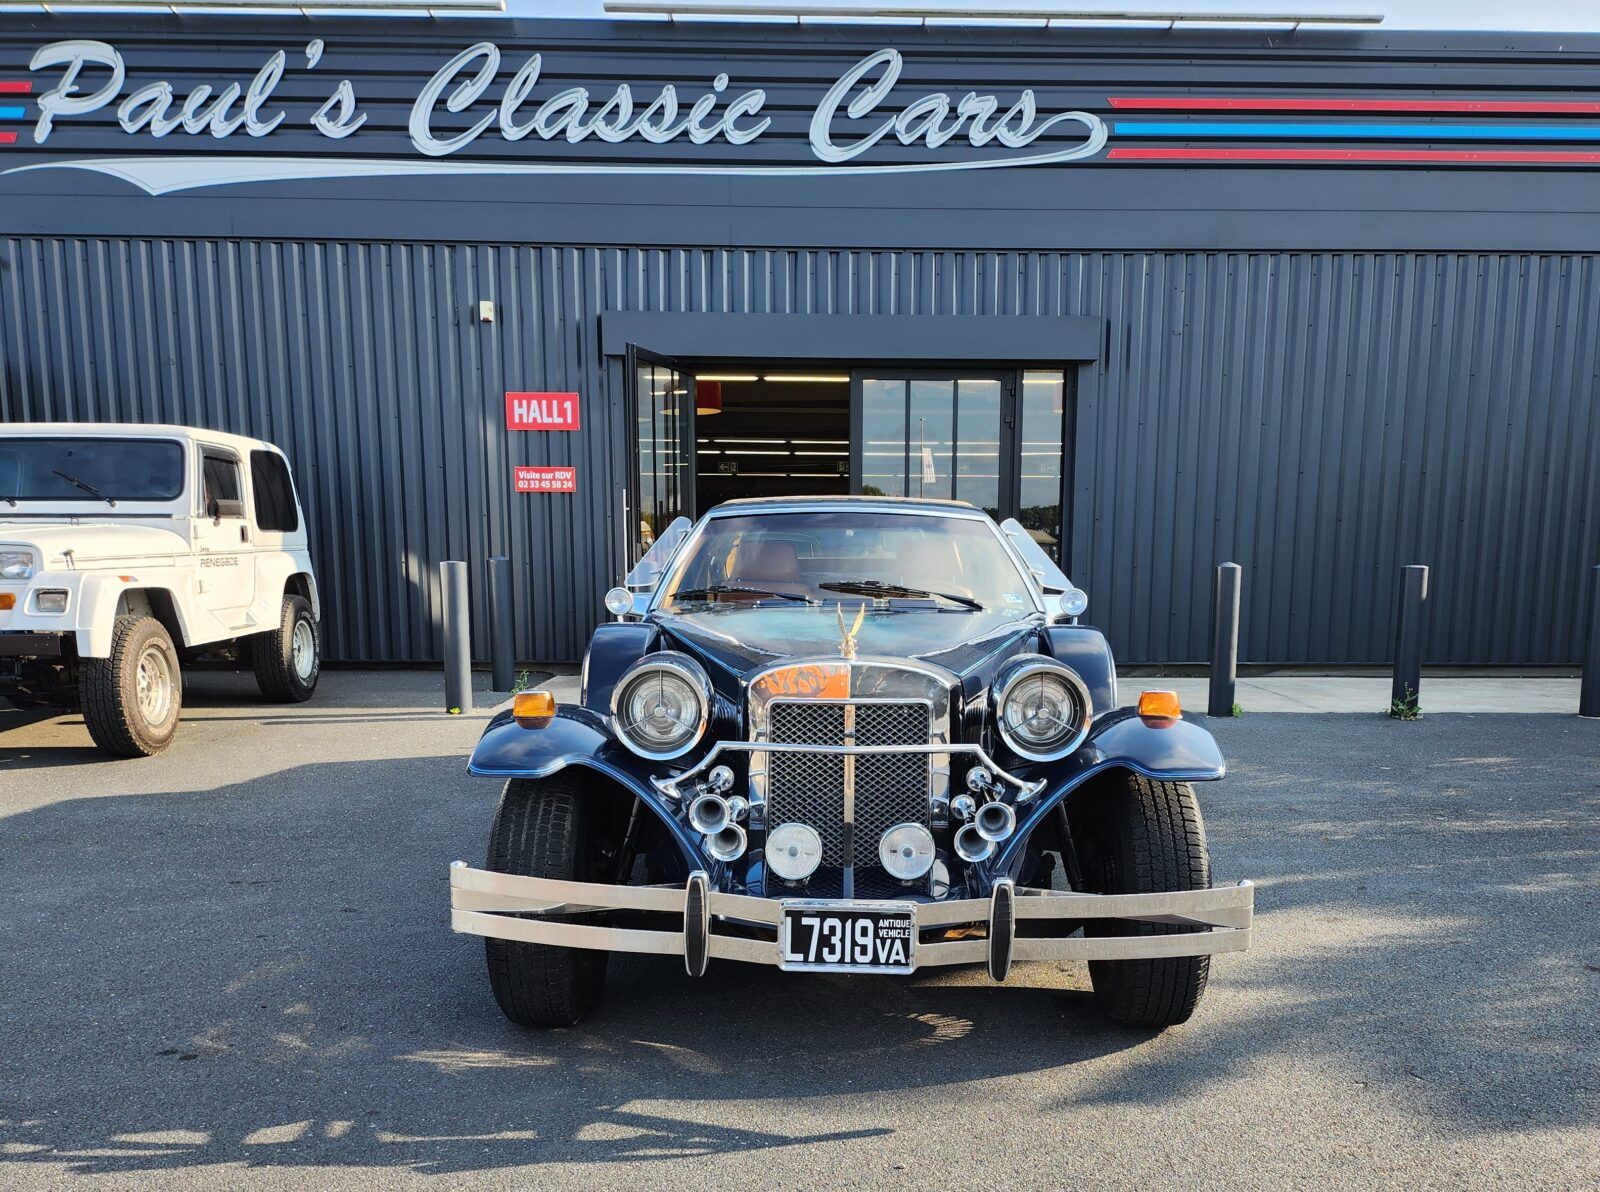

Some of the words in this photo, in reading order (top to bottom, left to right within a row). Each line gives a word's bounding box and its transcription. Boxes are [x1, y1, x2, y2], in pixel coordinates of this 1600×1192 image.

[28, 38, 368, 145] Paul's
[408, 41, 772, 156] Classic
[808, 48, 1108, 164] Cars
[518, 471, 541, 480] Visite
[554, 471, 572, 480] RDV
[518, 480, 529, 489] 02
[529, 480, 540, 489] 33
[540, 480, 551, 489] 45
[562, 480, 573, 489] 24
[200, 556, 239, 568] RENEGADE
[878, 919, 911, 928] ANTIQUE
[878, 928, 911, 938] VEHICLE
[785, 916, 875, 964] L7319
